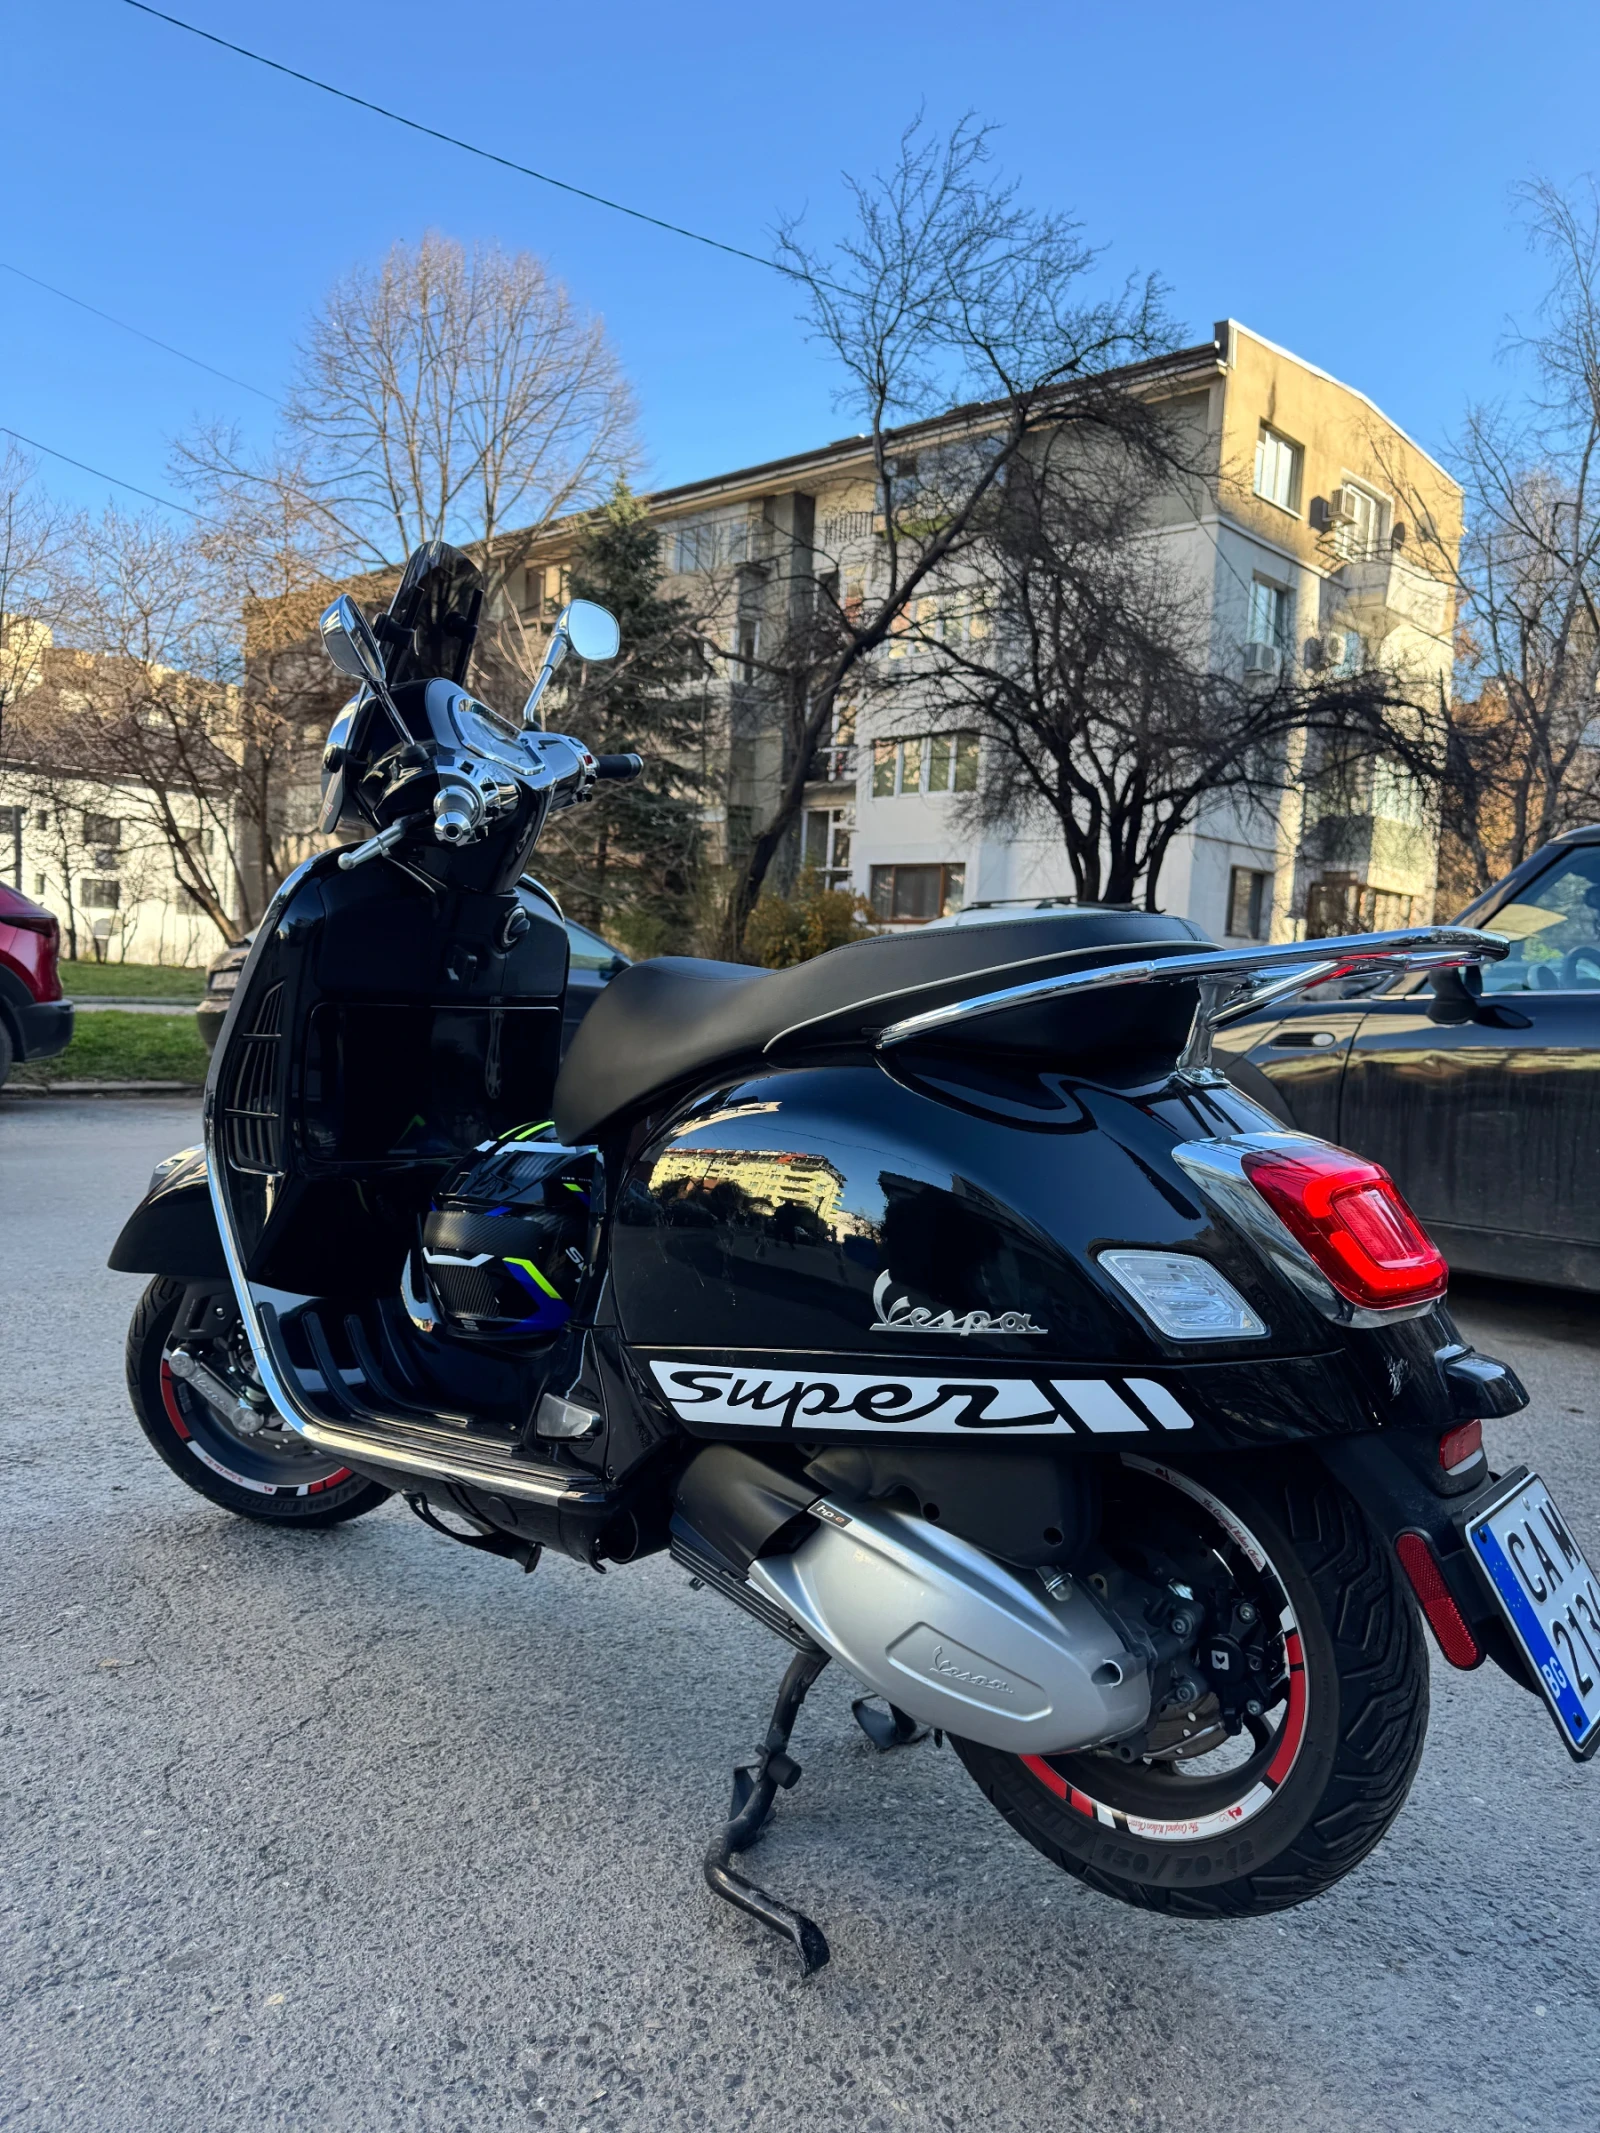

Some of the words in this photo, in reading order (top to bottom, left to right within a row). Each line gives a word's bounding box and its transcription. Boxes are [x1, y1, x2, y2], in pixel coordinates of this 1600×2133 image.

[870, 1269, 1048, 1336] Vespa
[929, 1646, 1014, 1694] Vespa
[1541, 1656, 1567, 1699] BG
[989, 1756, 1081, 1842] CHELIN
